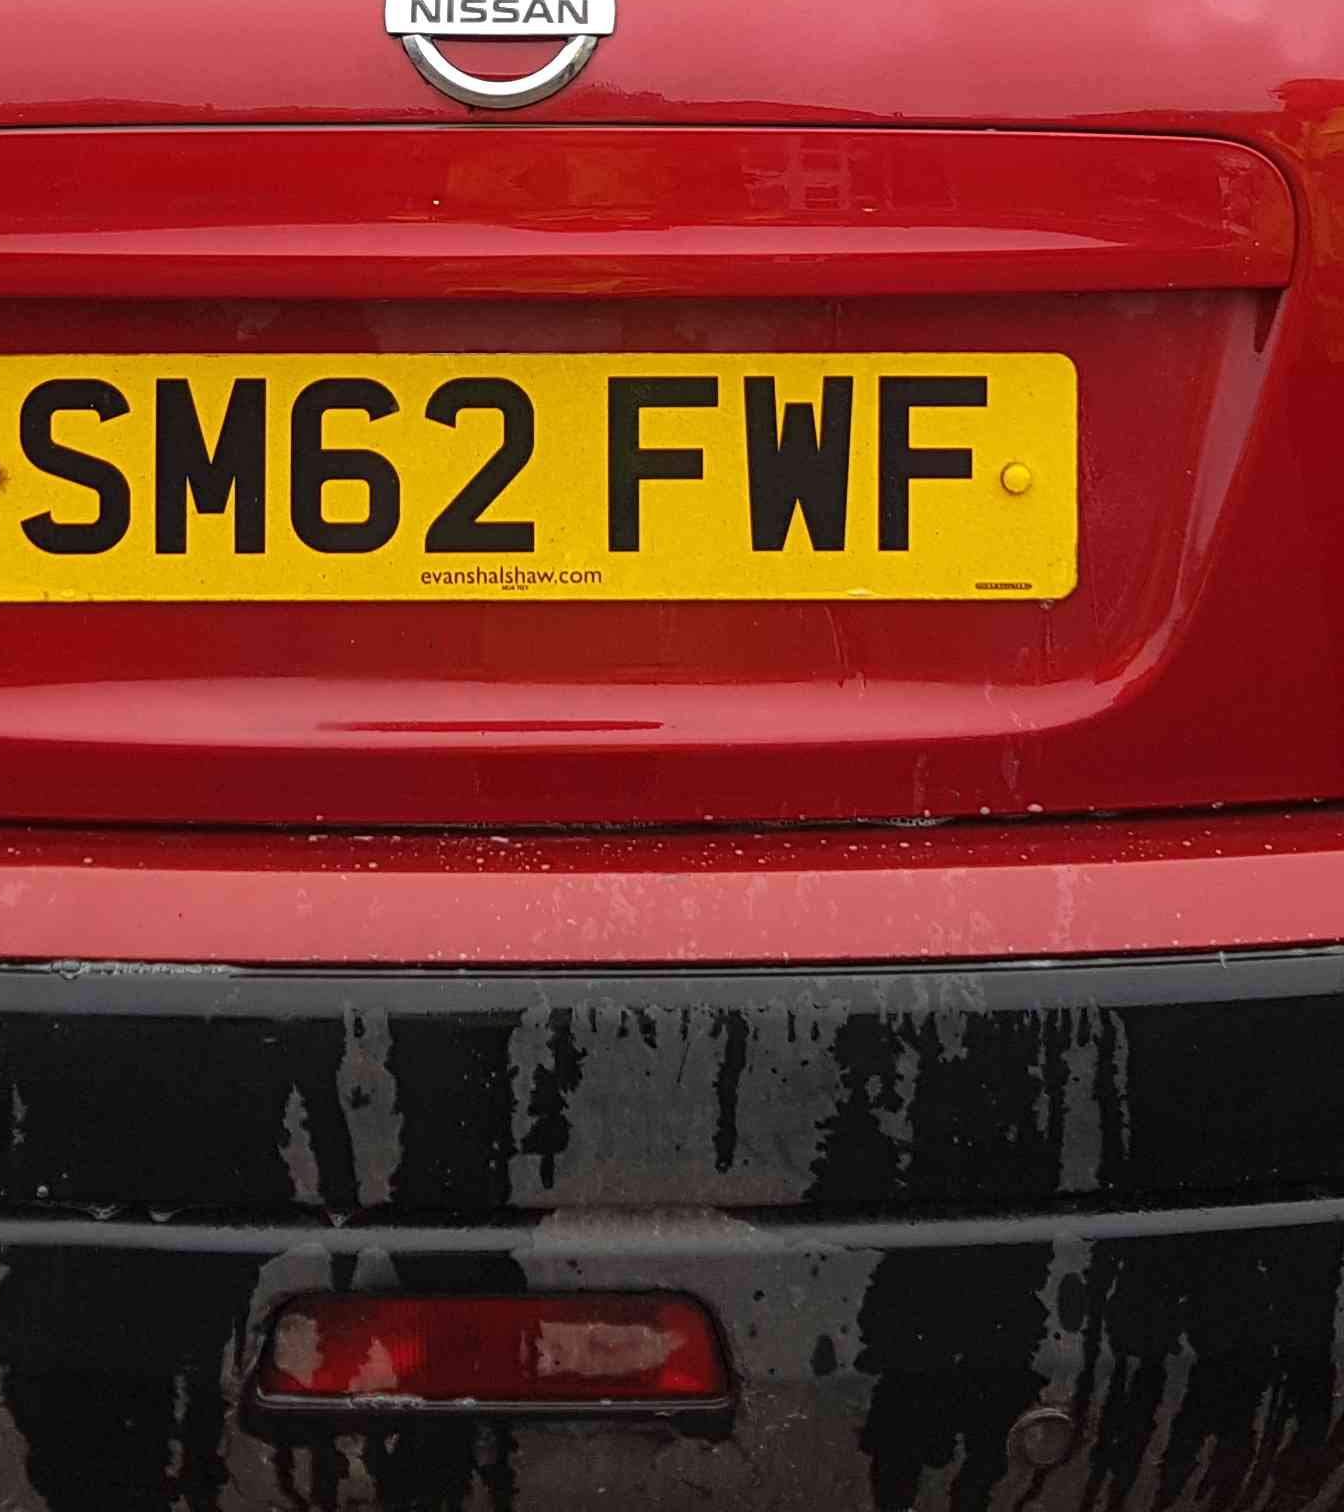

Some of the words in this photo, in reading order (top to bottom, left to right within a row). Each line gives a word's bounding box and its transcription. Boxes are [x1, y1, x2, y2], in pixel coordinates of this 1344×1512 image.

[19, 377, 535, 555] SM62
[608, 376, 988, 552] FWF
[420, 566, 602, 584] evanshalshaw.com
